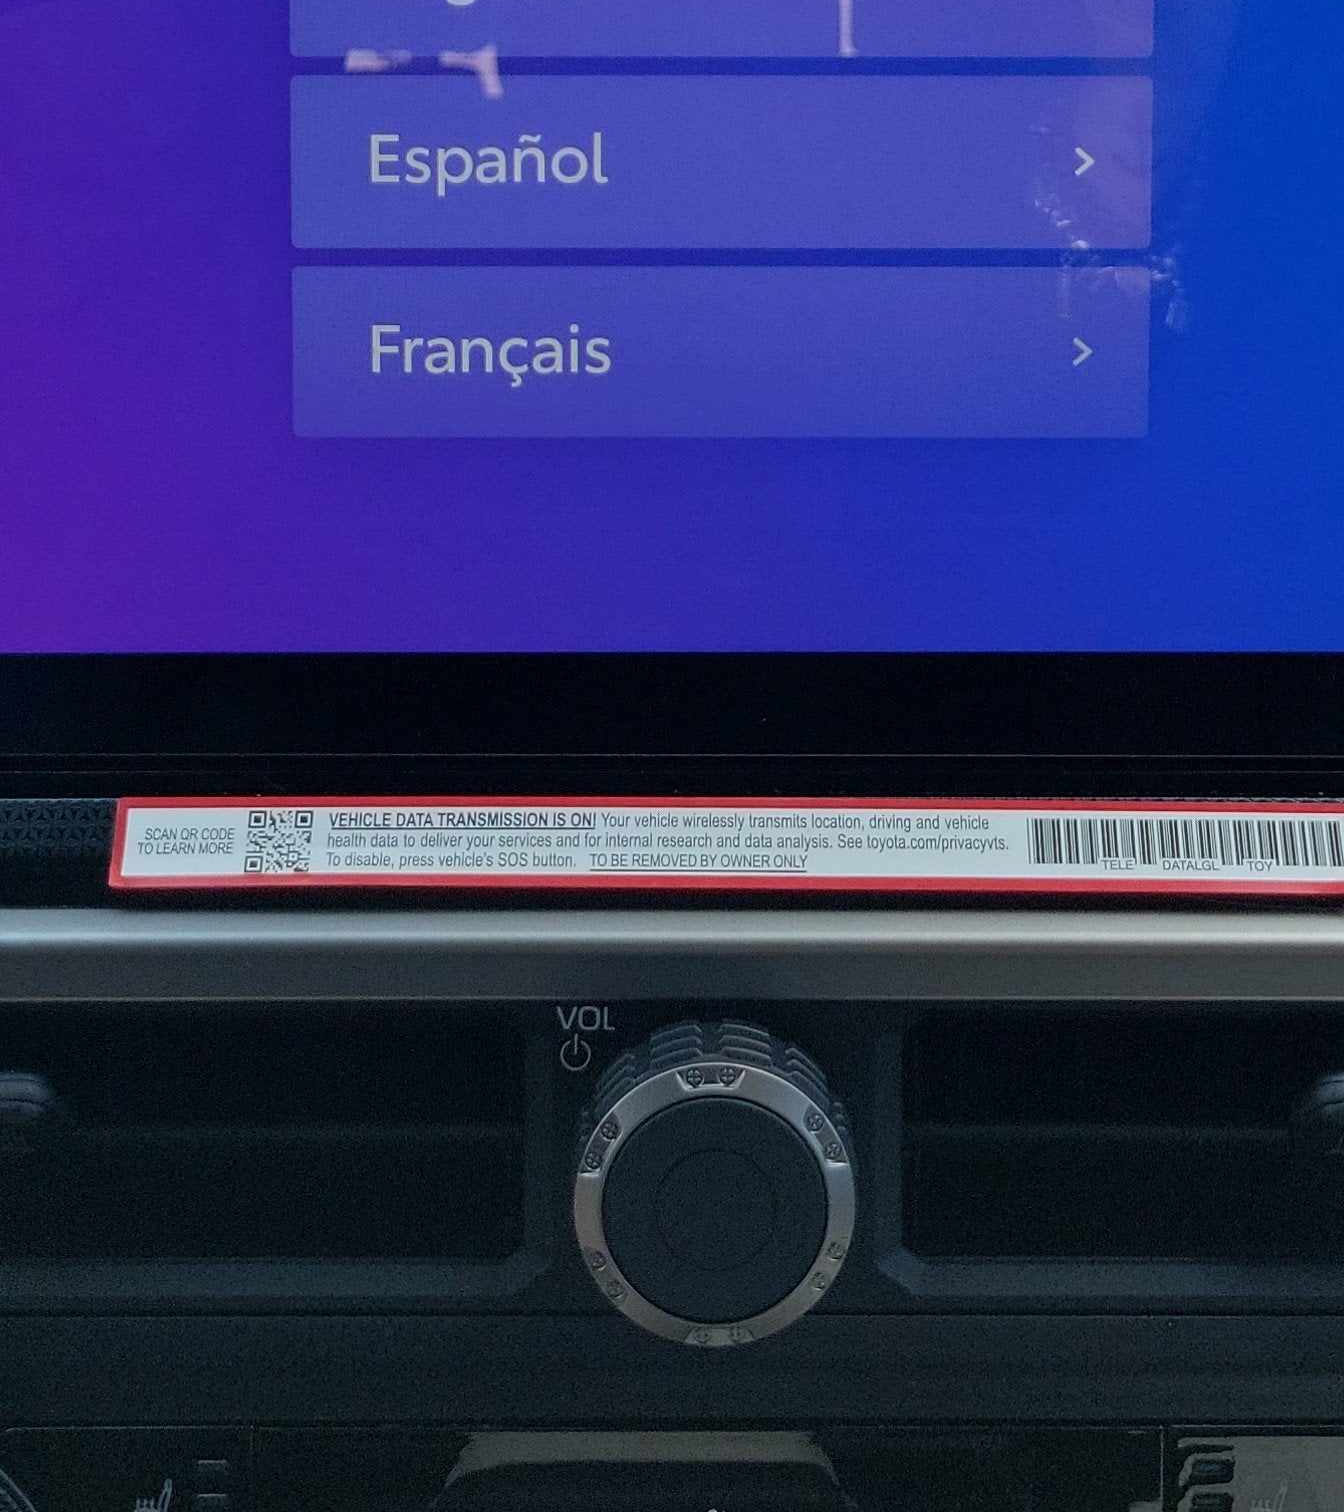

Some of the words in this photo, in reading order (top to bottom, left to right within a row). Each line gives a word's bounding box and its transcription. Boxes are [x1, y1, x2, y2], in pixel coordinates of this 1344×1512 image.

[369, 131, 609, 197] Español
[370, 323, 612, 388] Français
[329, 812, 391, 827] VEHICLE
[396, 812, 434, 827] DATA
[437, 812, 549, 827] TRANSMISSION
[553, 812, 566, 827] IS
[601, 812, 630, 828] Your
[634, 813, 678, 828] vehicle
[682, 813, 744, 832] wirelessly
[749, 814, 807, 828] transmits
[811, 814, 865, 832] location,
[869, 815, 912, 833] driving
[915, 815, 940, 829] and
[945, 815, 989, 830] vehicle
[144, 827, 179, 840] SCAN
[201, 827, 236, 840] CODE
[327, 833, 367, 847] health
[370, 833, 399, 847] data
[403, 833, 416, 847] to
[420, 833, 462, 847] deliver
[465, 836, 494, 851] your
[498, 834, 552, 848] services
[556, 833, 580, 847] and
[584, 833, 601, 847] for
[605, 833, 650, 848] internal
[657, 833, 712, 848] research
[716, 834, 740, 848] and
[744, 834, 772, 848] data
[776, 834, 833, 852] analysis.
[837, 834, 863, 849] See
[137, 842, 154, 855] TO
[156, 842, 196, 855] LEARN
[198, 842, 234, 855] MORE
[326, 852, 341, 867] To
[344, 852, 394, 869] disable,
[399, 855, 434, 869] press
[438, 851, 494, 867] vehicle's
[498, 852, 528, 868] SOS
[532, 852, 577, 867] button.
[589, 853, 607, 867] TO
[610, 853, 629, 867] BE
[632, 853, 697, 867] REMOVED
[700, 854, 717, 868] BY
[720, 854, 770, 868] OWNER
[773, 854, 808, 868] ONLY
[1101, 859, 1134, 871] TELE
[1162, 859, 1220, 872] DATALGL
[1246, 860, 1274, 872] TOY
[556, 1005, 616, 1031] VOL
